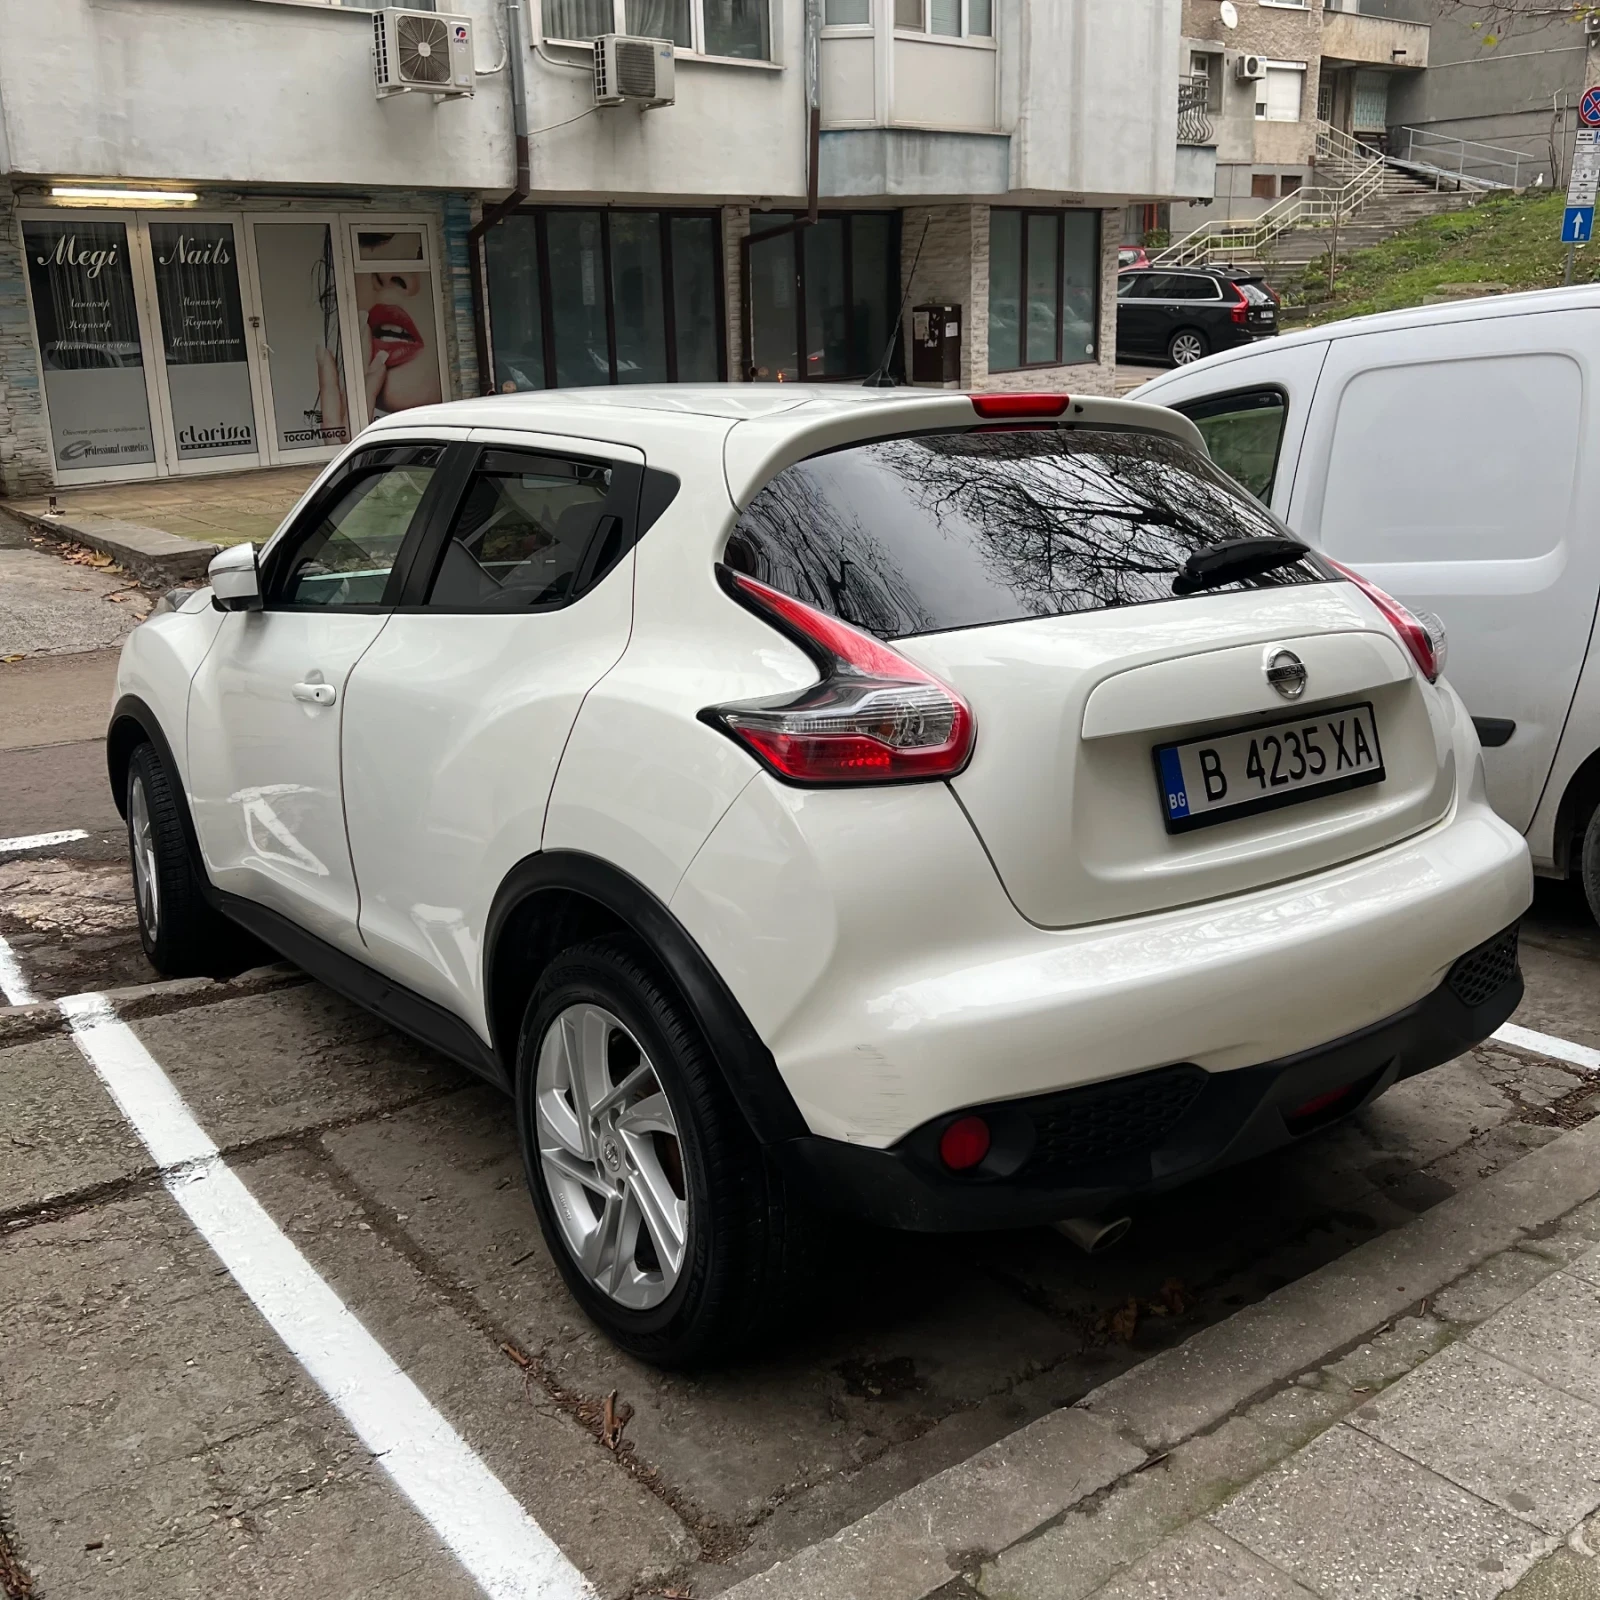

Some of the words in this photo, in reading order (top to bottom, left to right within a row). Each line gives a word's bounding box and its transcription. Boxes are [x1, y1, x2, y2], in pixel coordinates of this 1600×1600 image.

[37, 234, 119, 279] Megi
[159, 234, 232, 266] Nails
[179, 422, 251, 443] clarissa
[1199, 748, 1228, 801] B
[1246, 726, 1326, 789] 4235
[1328, 717, 1373, 771] XA
[1169, 791, 1186, 810] BG
